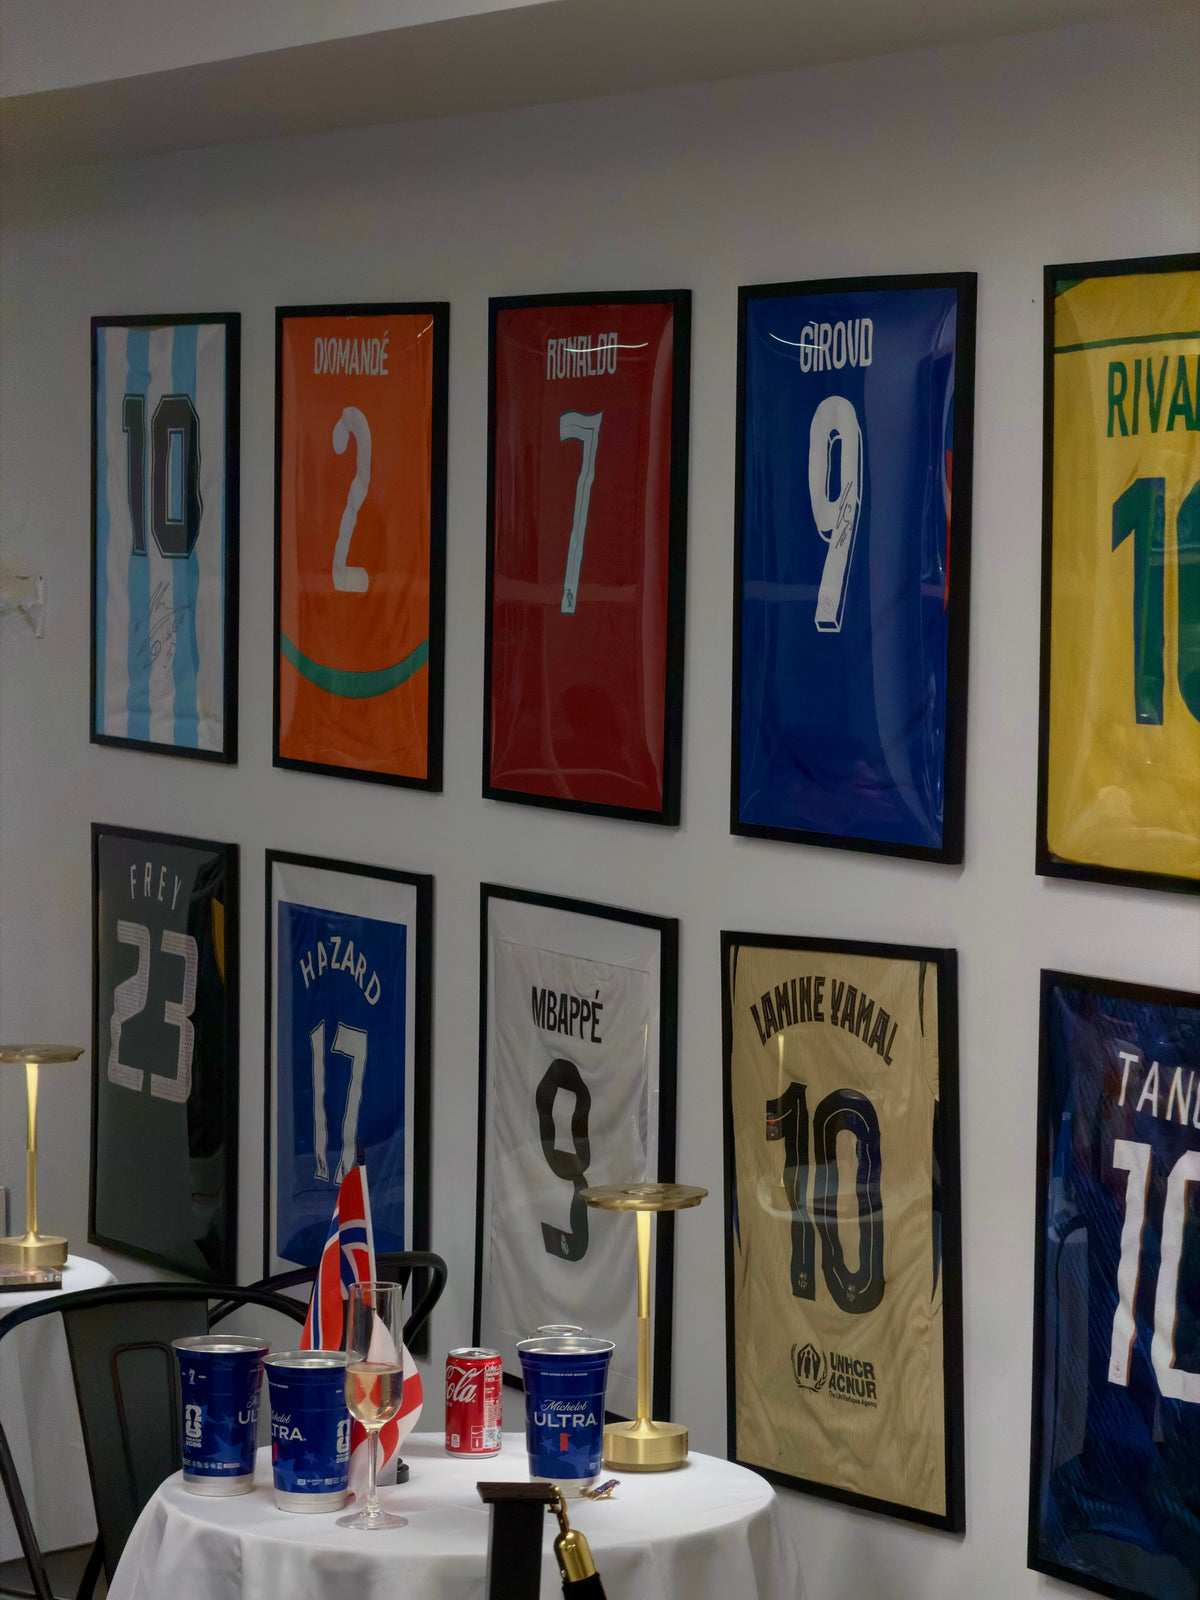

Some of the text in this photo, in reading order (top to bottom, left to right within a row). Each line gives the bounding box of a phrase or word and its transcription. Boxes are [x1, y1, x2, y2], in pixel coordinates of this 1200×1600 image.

[313, 330, 390, 377] DIOMANDÉ
[546, 332, 618, 381] RONALDO
[800, 317, 874, 373] GIROUD
[1106, 355, 1200, 438] RIVA
[122, 393, 203, 559] 10
[332, 406, 372, 593] 2
[559, 410, 603, 615] 7
[808, 395, 863, 633] 9
[130, 862, 182, 910] FREY
[300, 936, 381, 1006] HAZARD
[107, 919, 199, 1104] 23
[531, 986, 603, 1044] MBAPPÉ
[750, 976, 899, 1067] LAMINE YAMAL
[310, 1018, 368, 1186] 17
[535, 1058, 592, 1262] 9
[766, 1082, 886, 1315] 10
[828, 1372, 877, 1400] ACNUR
[829, 1352, 876, 1381] UNHCR
[271, 1423, 304, 1442] TRA
[534, 1411, 598, 1428] ULTRA
[540, 1399, 588, 1412] Michelob
